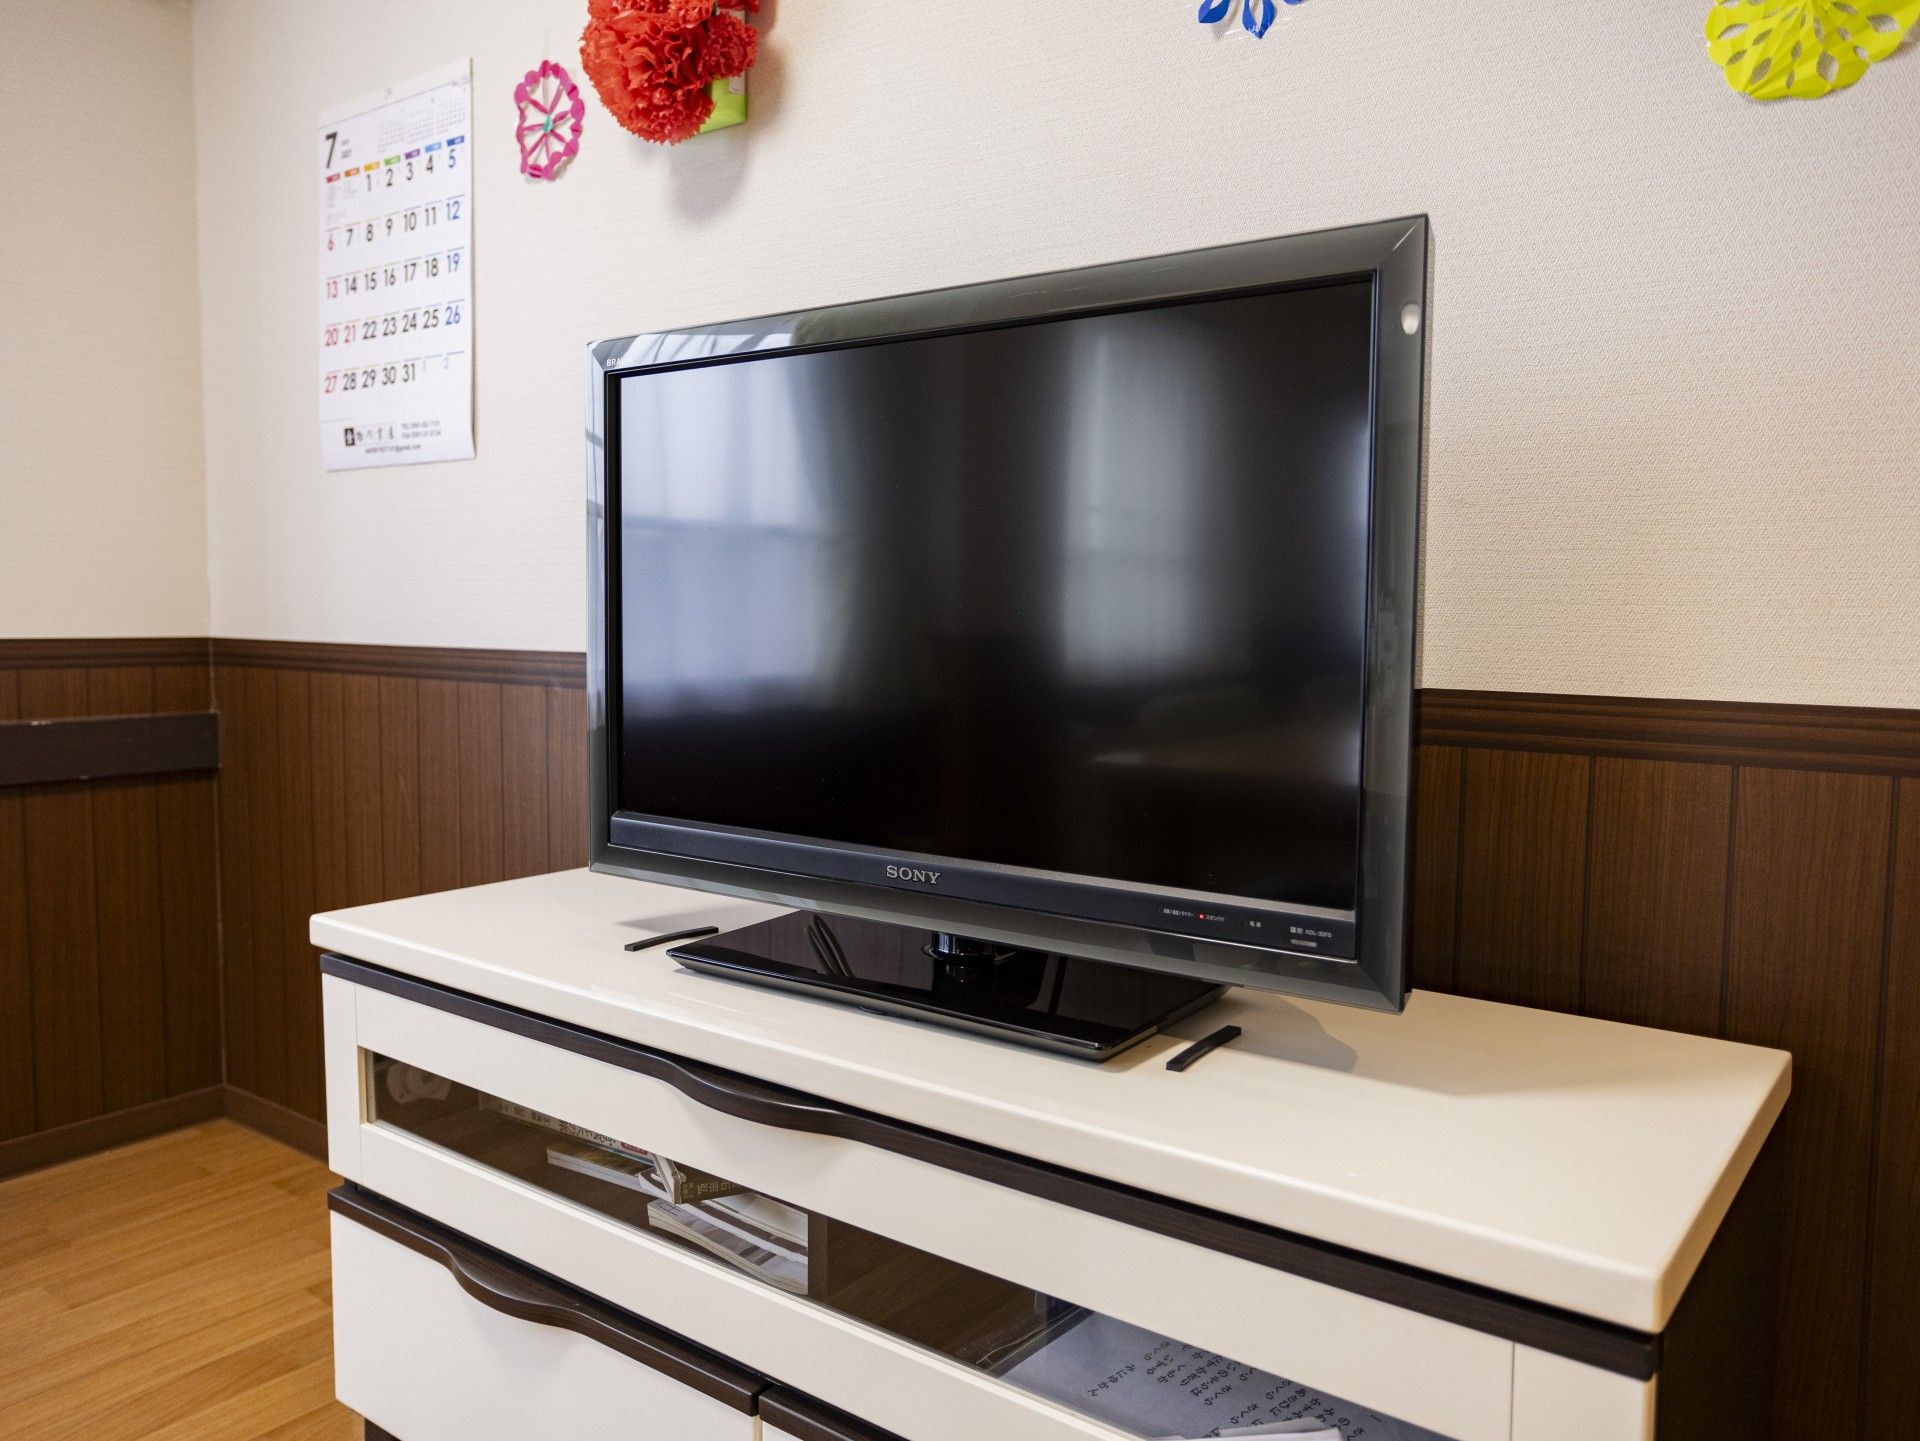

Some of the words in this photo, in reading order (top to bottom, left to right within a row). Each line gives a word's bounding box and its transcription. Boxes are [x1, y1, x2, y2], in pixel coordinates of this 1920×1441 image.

[325, 132, 338, 168] 7
[366, 174, 372, 191] 1
[385, 169, 393, 187] 2
[405, 162, 414, 180] 3
[426, 155, 434, 173] 4
[448, 150, 456, 168] 5
[327, 233, 335, 251] 6
[346, 228, 354, 245] 7
[366, 224, 374, 242] 8
[386, 218, 393, 236] 9
[404, 212, 417, 232] 10
[425, 206, 437, 226] 11
[446, 200, 461, 221] 12
[326, 280, 338, 299] 13
[344, 276, 357, 295] 14
[364, 272, 377, 291] 15
[384, 268, 396, 287] 16
[403, 263, 417, 282] 17
[425, 258, 439, 278] 18
[447, 253, 460, 273] 19
[325, 327, 339, 346] 20
[344, 324, 356, 344] 21
[362, 321, 376, 340] 22
[382, 316, 397, 336] 23
[402, 313, 417, 333] 24
[422, 309, 439, 329] 25
[445, 304, 461, 325] 26
[324, 375, 338, 394] 27
[342, 372, 357, 391] 28
[362, 369, 376, 388] 29
[381, 366, 396, 385] 30
[402, 363, 416, 382] 31
[886, 865, 940, 884] SONY
[1087, 1364, 1136, 1397] みにゆかん
[1156, 1364, 1186, 1384] くもか
[1266, 1380, 1292, 1400] さくら
[1204, 1384, 1233, 1406] さくら
[1230, 1403, 1259, 1424] さくら
